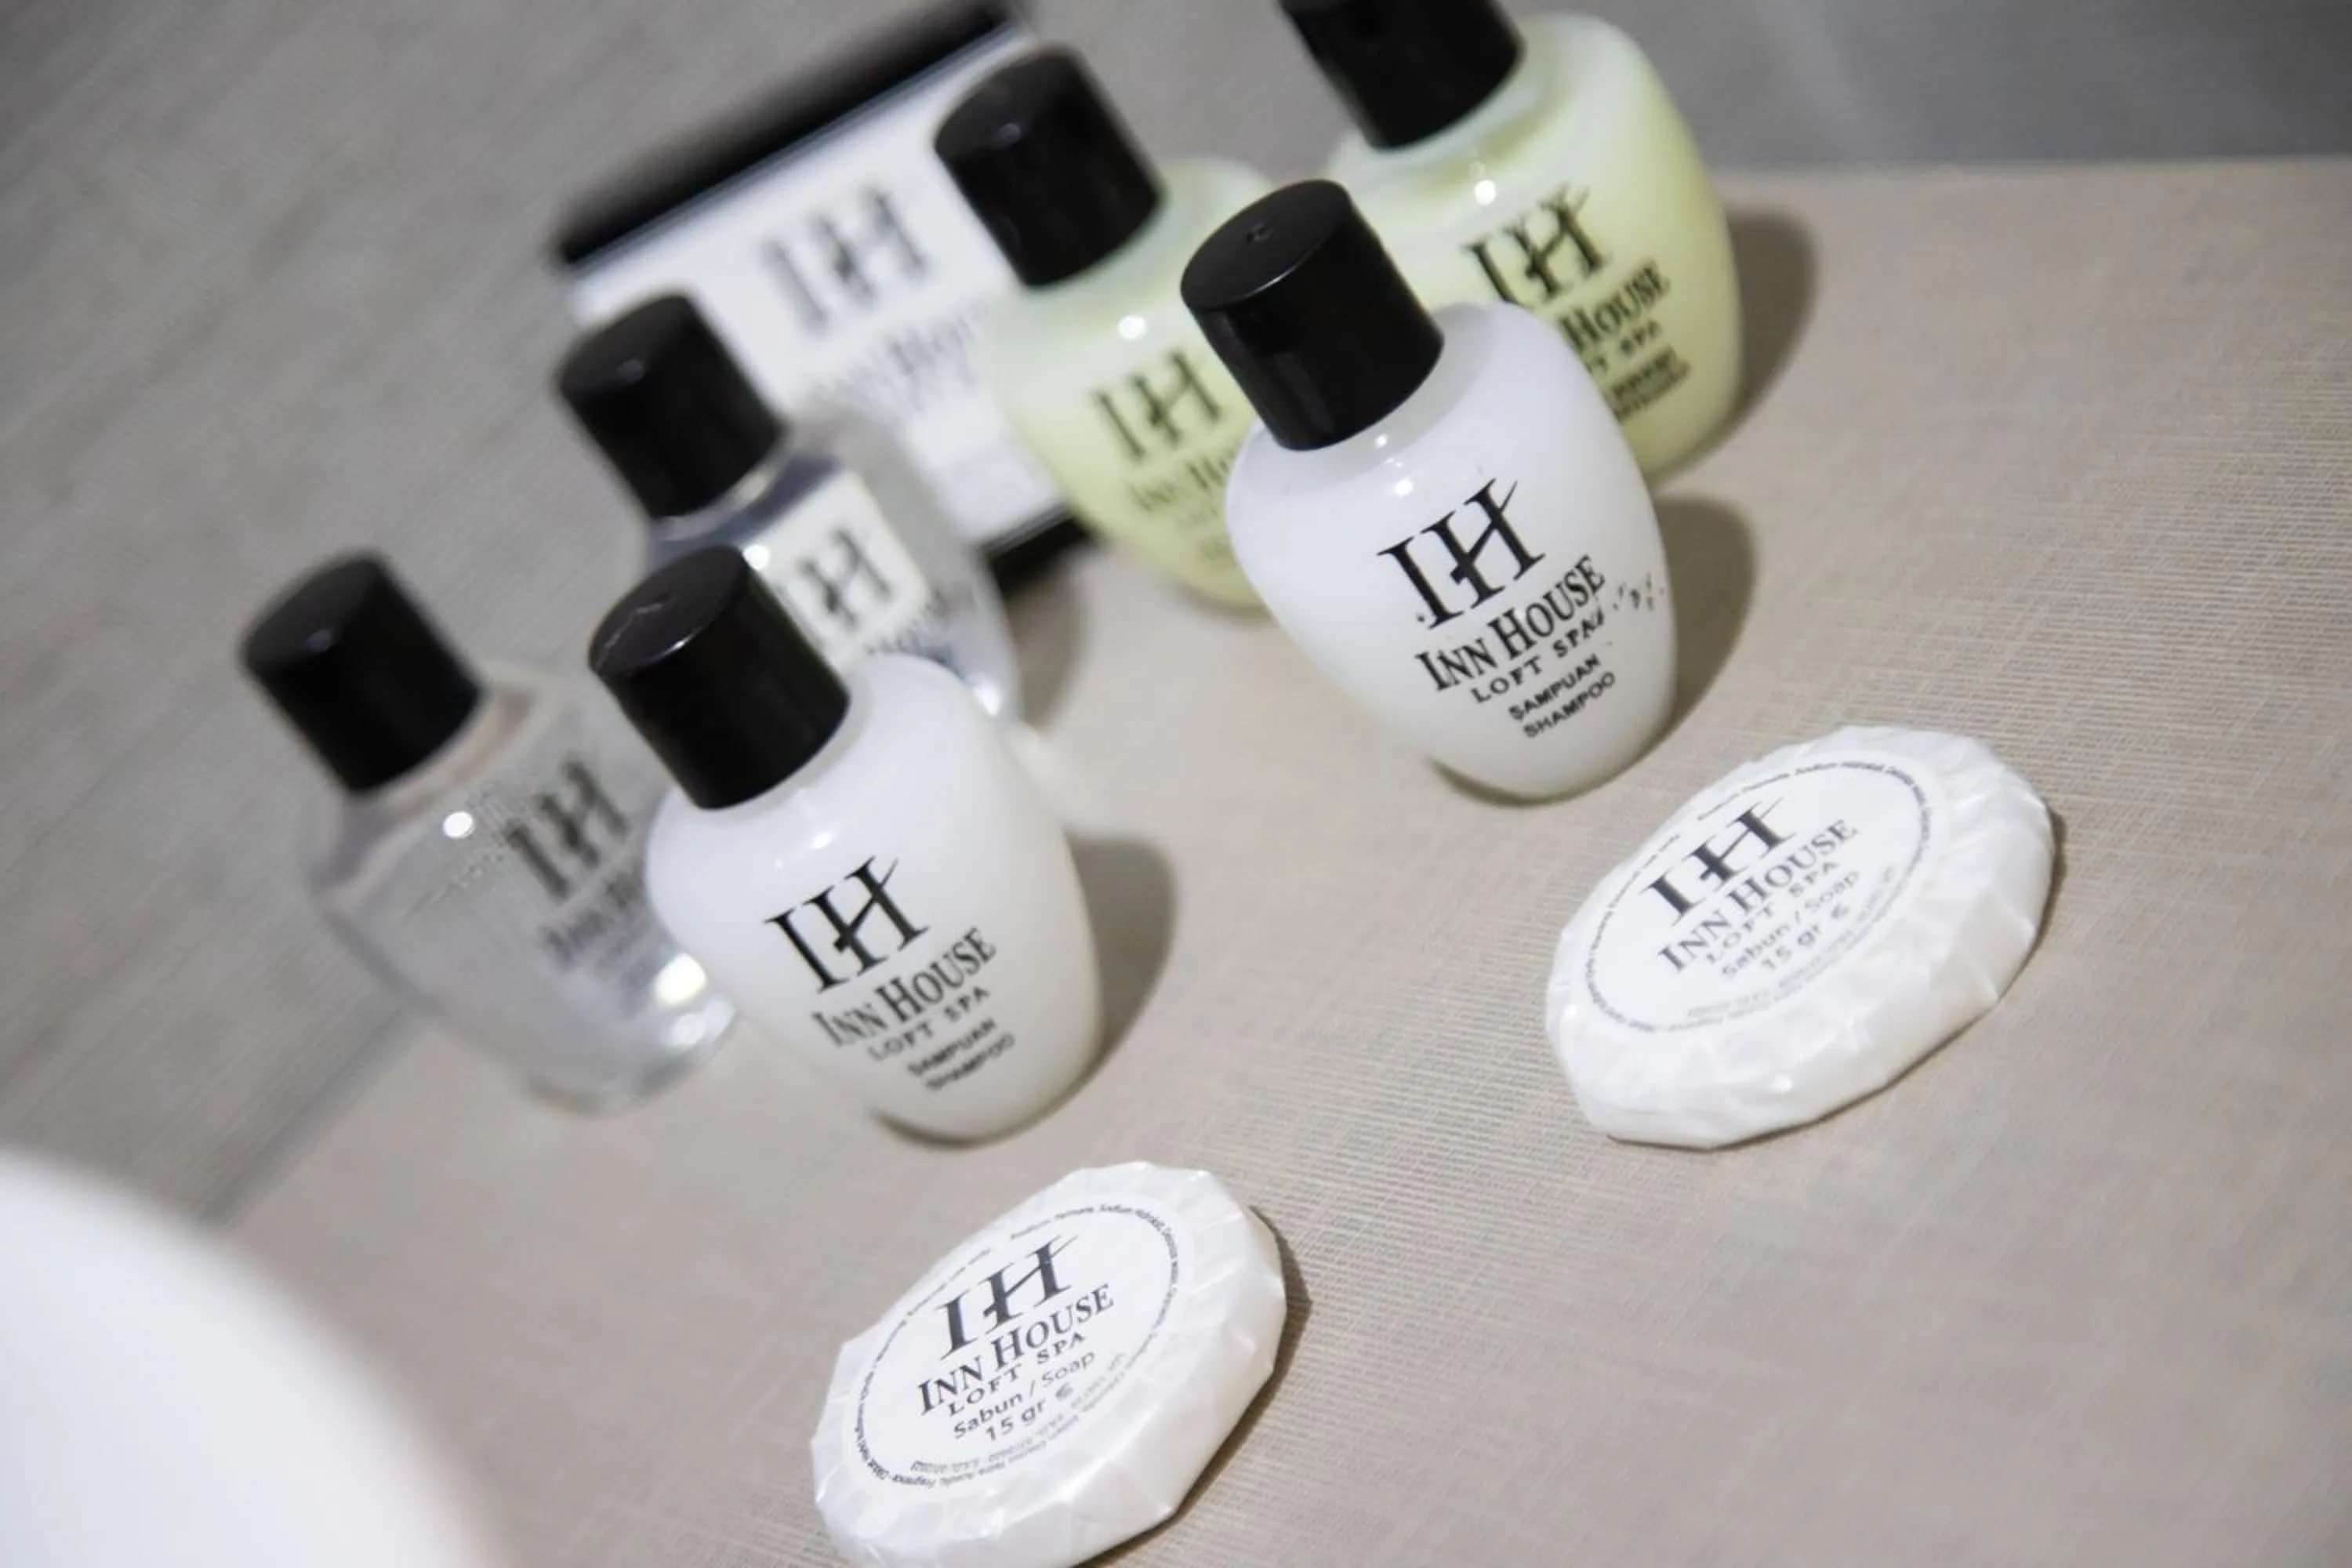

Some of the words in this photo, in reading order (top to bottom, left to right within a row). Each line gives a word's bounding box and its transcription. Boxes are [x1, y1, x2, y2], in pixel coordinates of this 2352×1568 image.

[1377, 477, 1546, 630] IH
[1415, 637, 1497, 692] INN
[1487, 554, 1606, 660] HOUSE
[1471, 655, 1542, 703] LOFT
[1552, 614, 1602, 659] SPA
[1508, 653, 1601, 720] SAMPUAN
[1523, 671, 1616, 739] SHAMPOO
[1638, 796, 1798, 928] IH
[1657, 909, 1732, 975] INN
[1726, 819, 1858, 915] HOUSE
[1705, 902, 1775, 964] LOFT
[1788, 861, 1839, 898] SPA
[762, 855, 931, 994] IH
[1722, 924, 1790, 980] Sabun
[1804, 871, 1860, 913] Soap
[1762, 945, 1793, 971] 15
[811, 1002, 888, 1049] INN
[875, 926, 996, 1023] HOUSE
[867, 1018, 935, 1062] LOFT
[916, 1355, 983, 1417] INN
[991, 1283, 1114, 1372] HOUSE
[935, 1235, 1080, 1361] IH
[947, 1363, 1023, 1417] LOFT
[1036, 1332, 1085, 1364] SPA
[953, 1392, 1023, 1439] Sabun
[1041, 1351, 1095, 1388] Soap
[985, 1417, 1014, 1442] 15
[1022, 1399, 1047, 1428] gr
